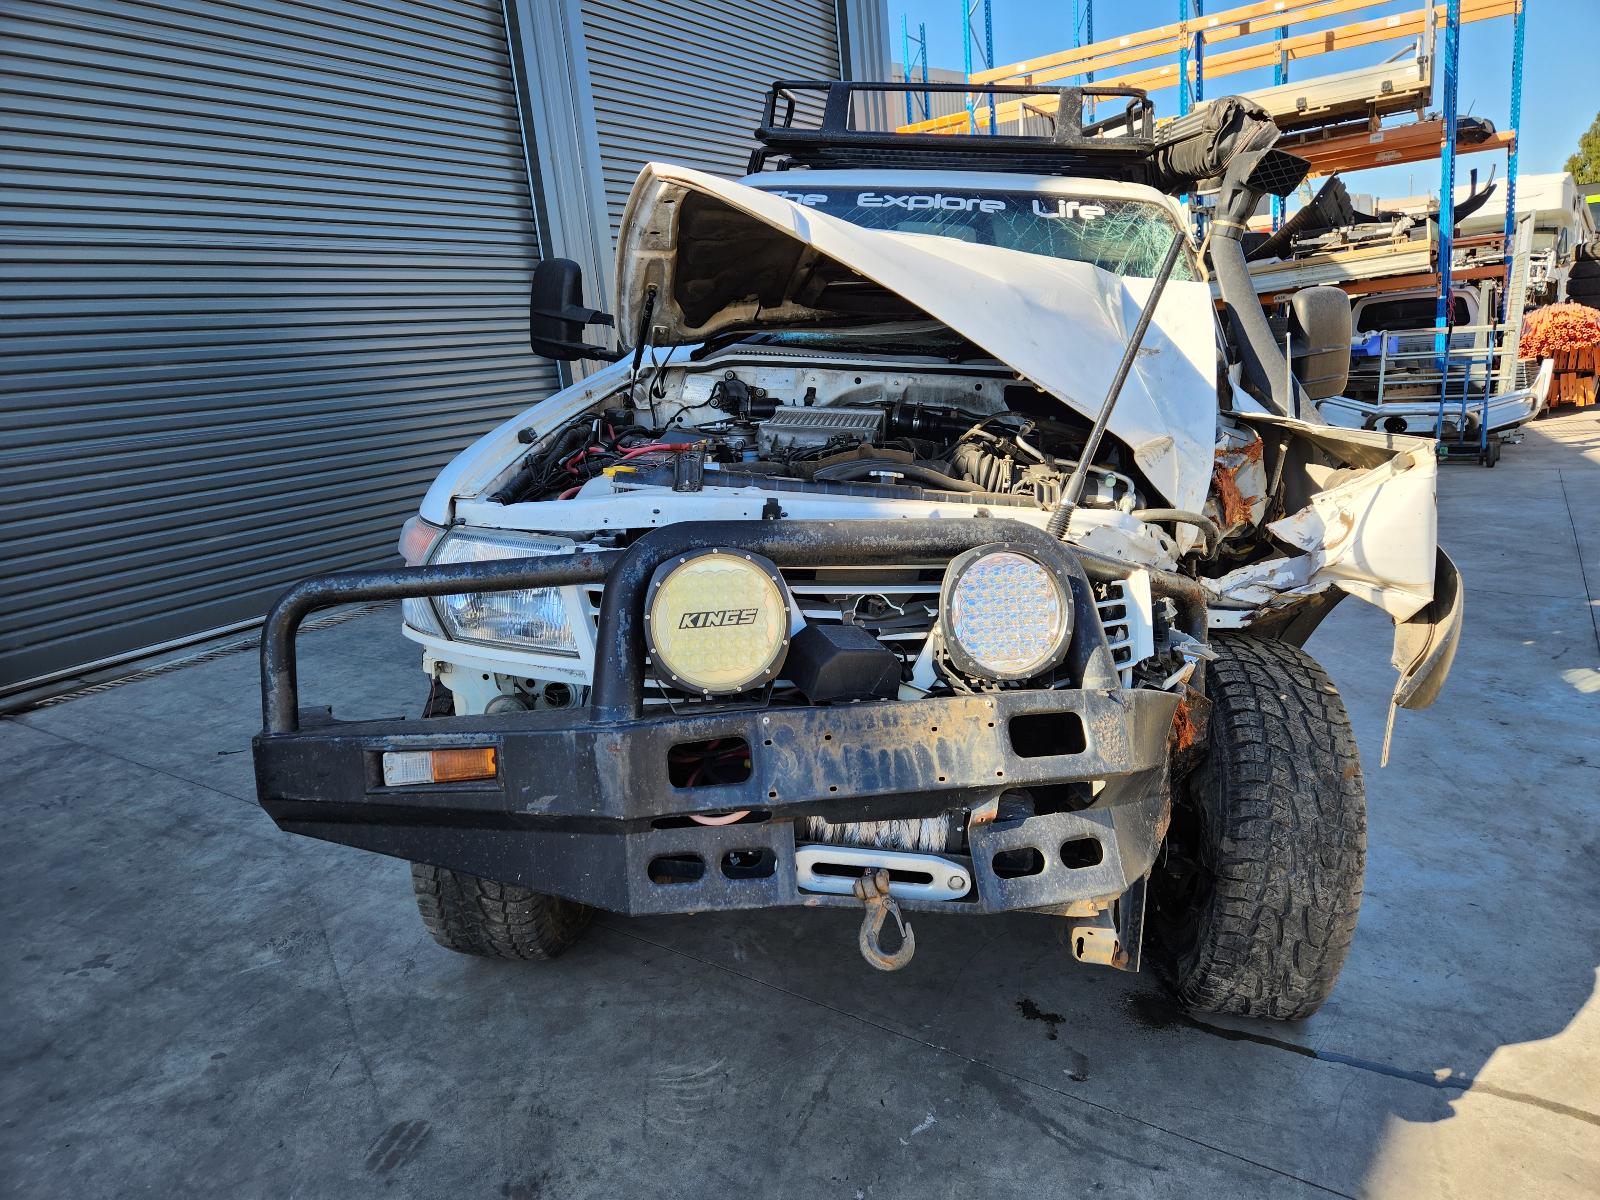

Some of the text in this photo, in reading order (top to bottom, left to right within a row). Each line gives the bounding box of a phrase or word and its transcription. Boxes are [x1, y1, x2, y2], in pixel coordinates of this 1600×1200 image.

[856, 192, 1006, 213] Explore
[1032, 199, 1105, 219] Life
[679, 608, 758, 629] KINGS
